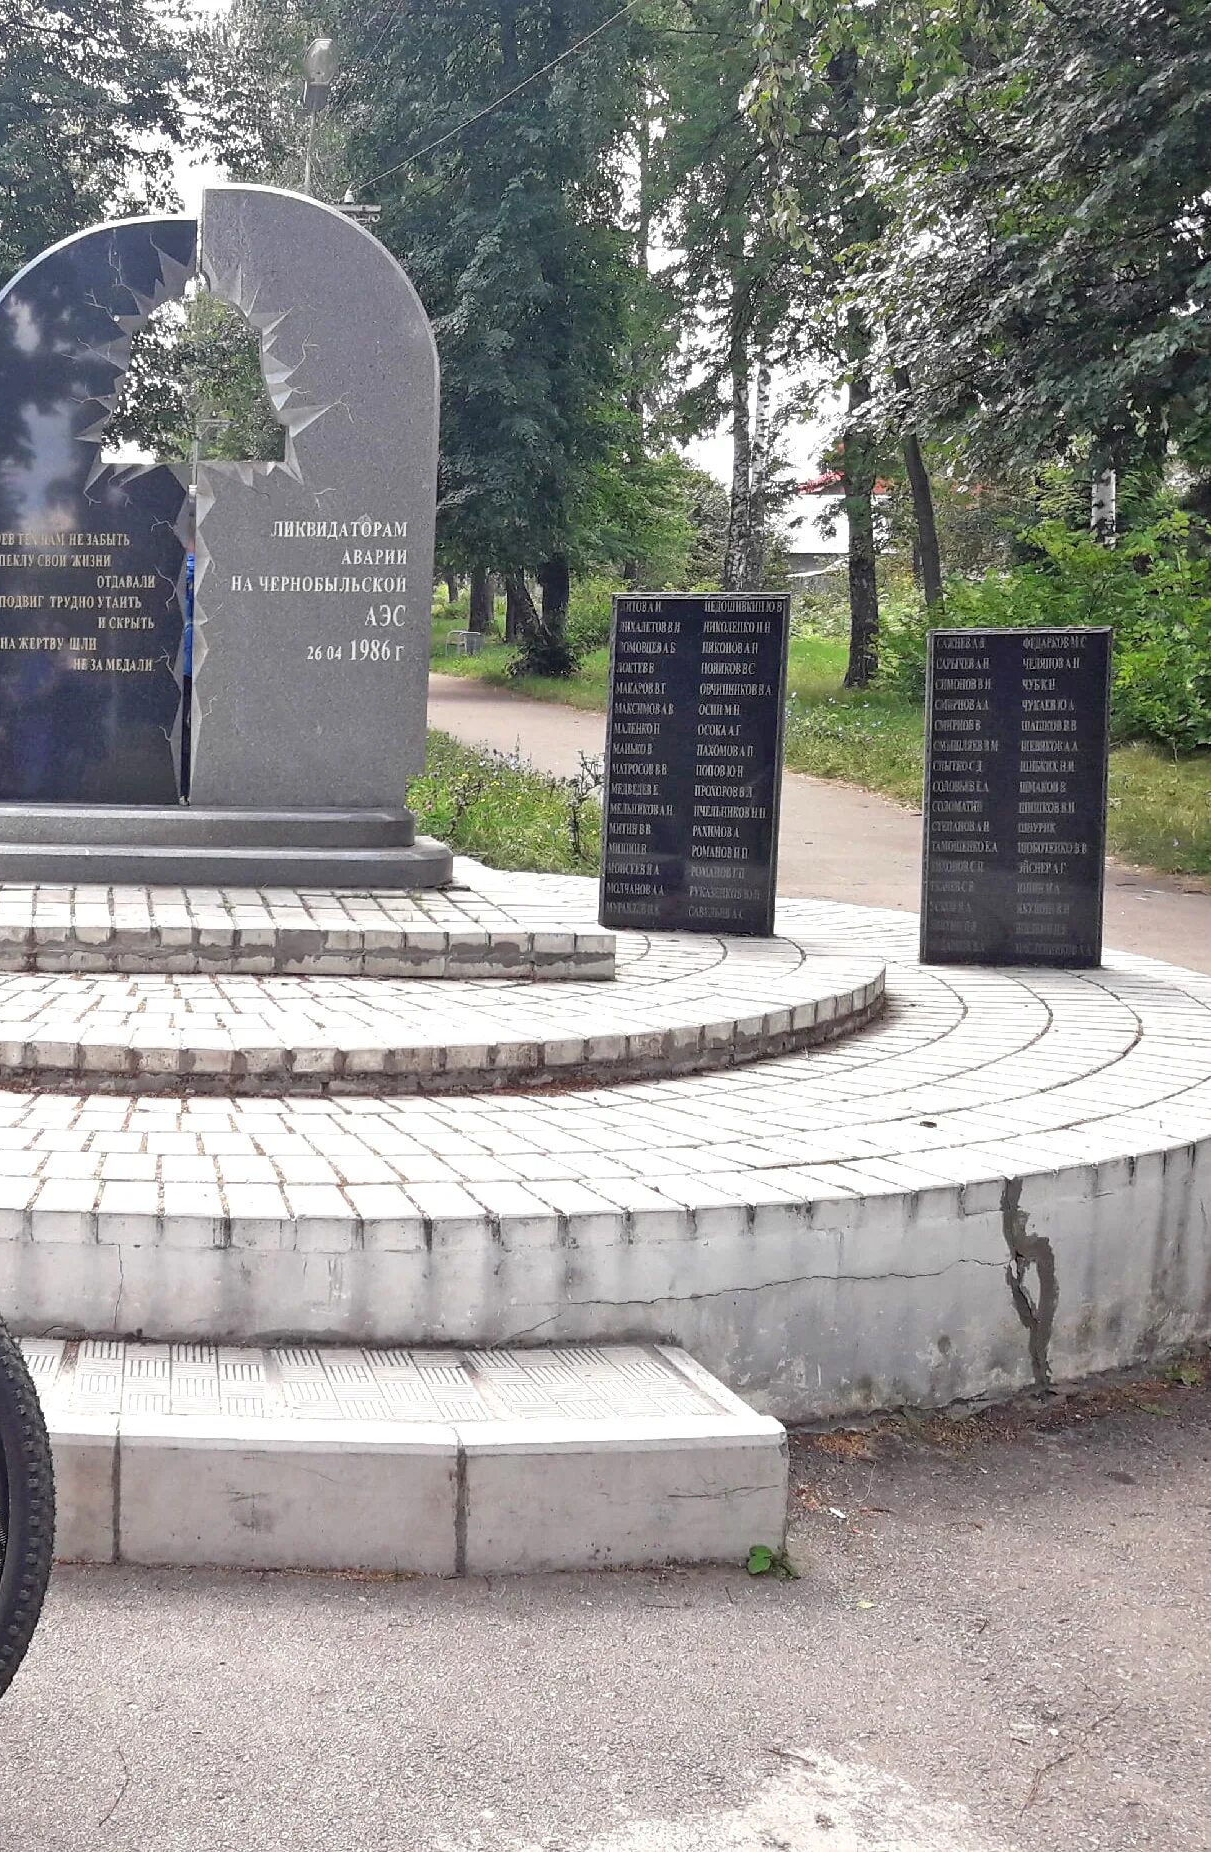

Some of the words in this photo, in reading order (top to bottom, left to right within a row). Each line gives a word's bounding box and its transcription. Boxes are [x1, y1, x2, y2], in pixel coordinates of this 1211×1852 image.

[271, 521, 408, 540] ЛИКВИДАТОРАМ
[69, 533, 84, 546] НЕ
[86, 533, 131, 547] ЗАБЫТЬ
[38, 554, 67, 567] СВОИ
[71, 554, 112, 568] ЖИЗНИ
[341, 549, 407, 565] АВАРИИ
[97, 575, 156, 589] ОТДАВАЛИ
[231, 575, 253, 592] НА
[259, 574, 407, 593] ЧЕРНОБЫЛЬСКОЙ
[50, 596, 95, 610] ТРУДНО
[97, 595, 142, 609] УТАИТЬ
[364, 604, 406, 627] АЭС
[98, 617, 107, 629] И
[109, 617, 156, 629] СКРЫТЬ
[0, 637, 16, 650] НА
[18, 637, 65, 651] ЖЕРТВУ
[69, 637, 97, 651] ШЛИ
[307, 646, 323, 660] 26
[327, 646, 342, 660] 04
[349, 639, 391, 661] 1986
[73, 658, 88, 671] НЕ
[90, 659, 104, 671] ЗА
